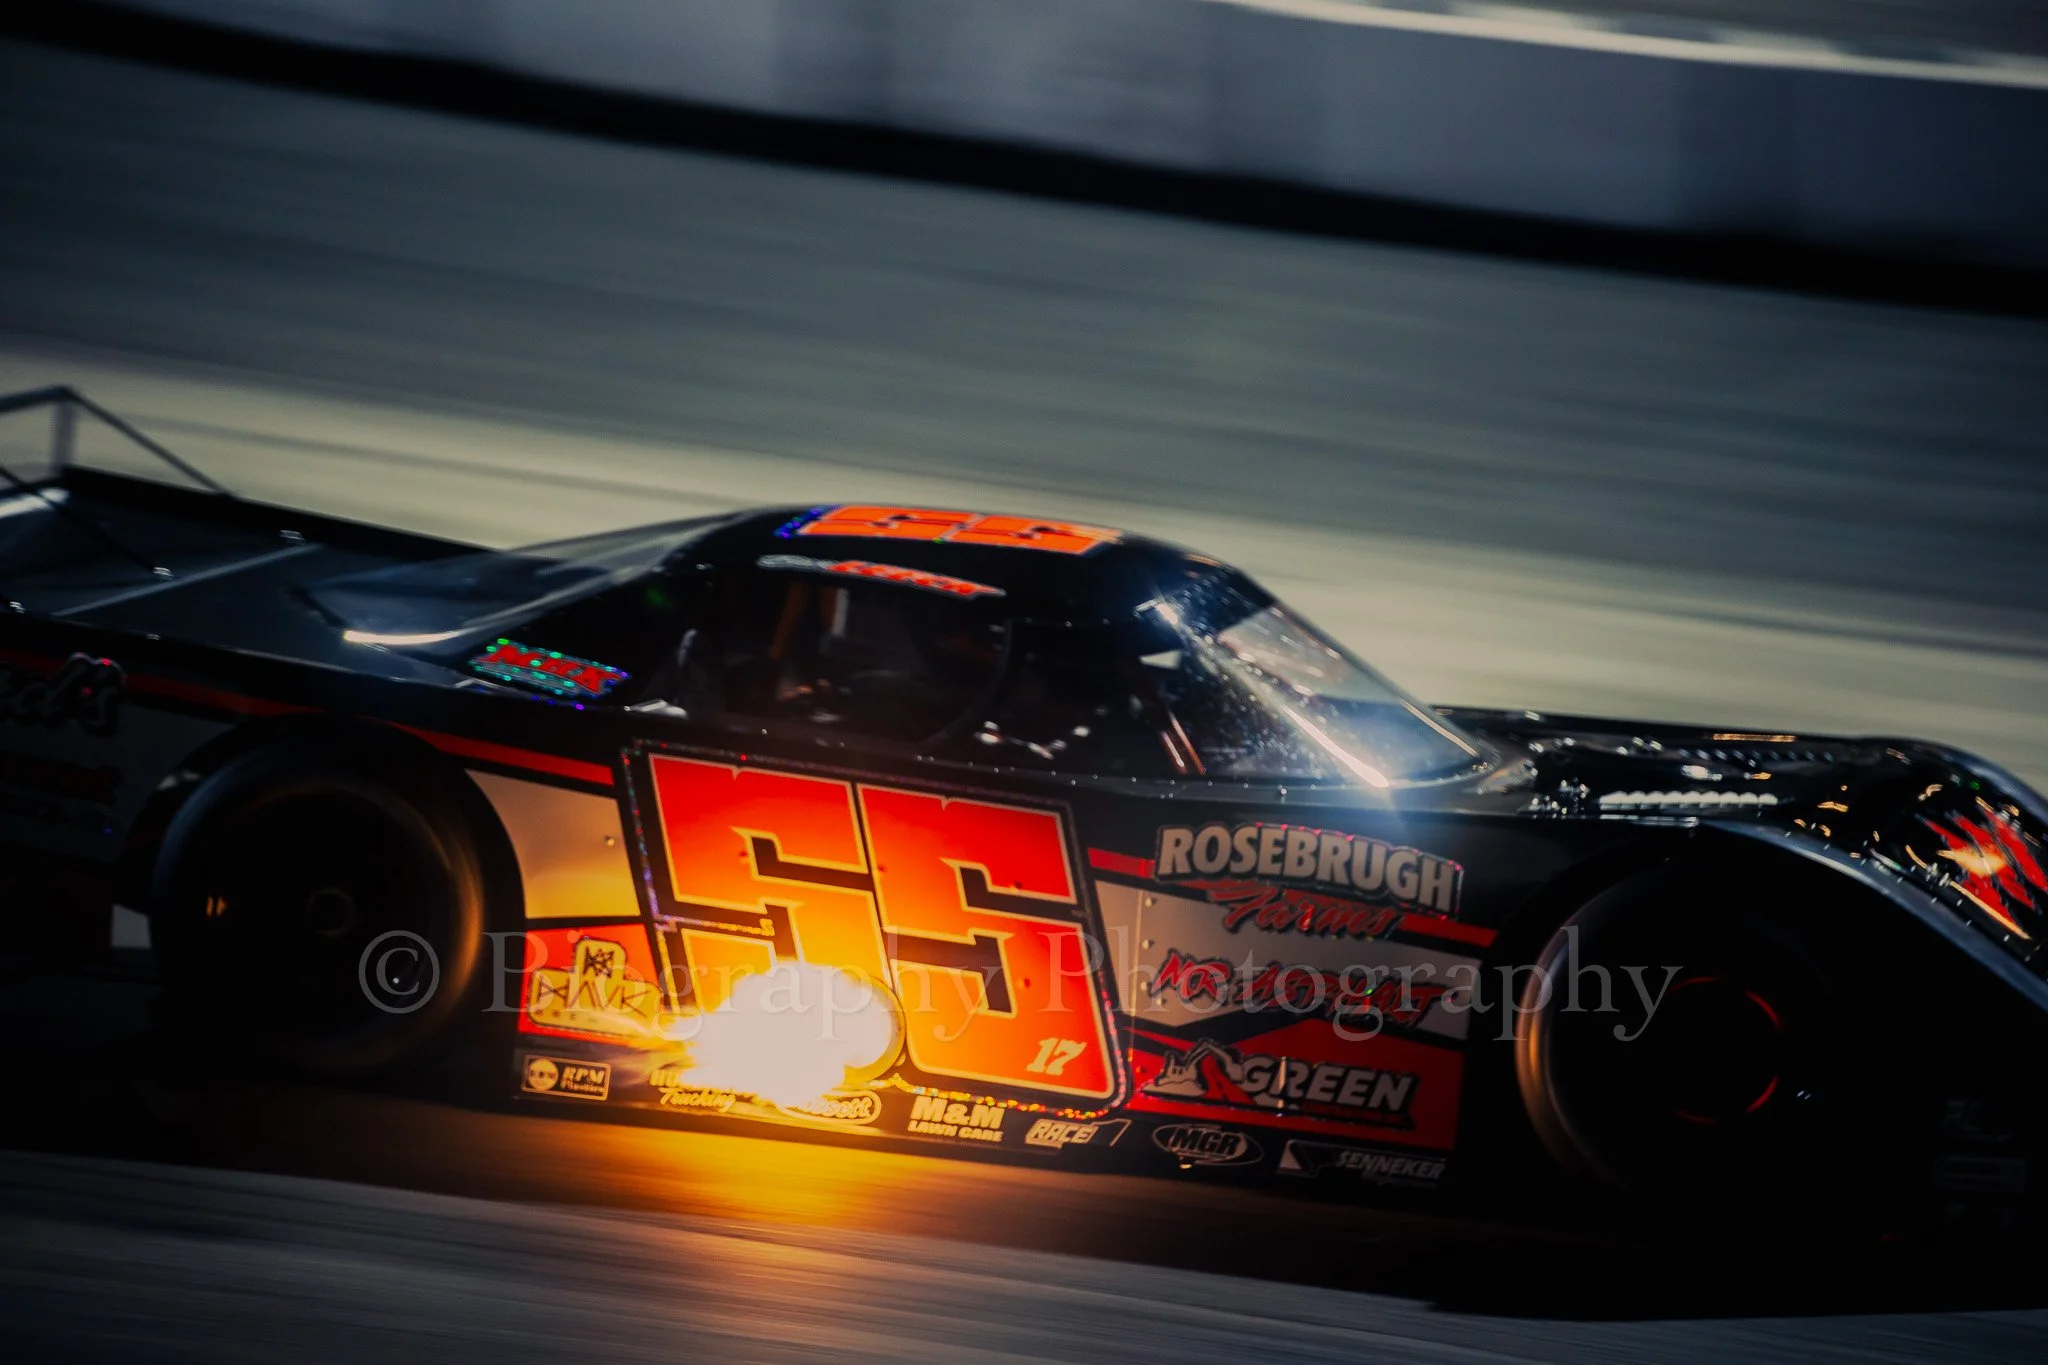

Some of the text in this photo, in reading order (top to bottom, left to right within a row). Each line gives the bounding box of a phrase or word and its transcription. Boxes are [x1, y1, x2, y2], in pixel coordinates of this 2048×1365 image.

[1155, 824, 1460, 914] ROSEBRUGH
[648, 753, 1115, 1100] 55
[1209, 884, 1398, 936] Farms
[1025, 1037, 1087, 1076] 17
[1240, 1055, 1417, 1112] GREEN
[907, 1119, 1004, 1142] LAWN CARE
[910, 1095, 1005, 1130] M&M
[1335, 1150, 1446, 1180] SENNEKER
